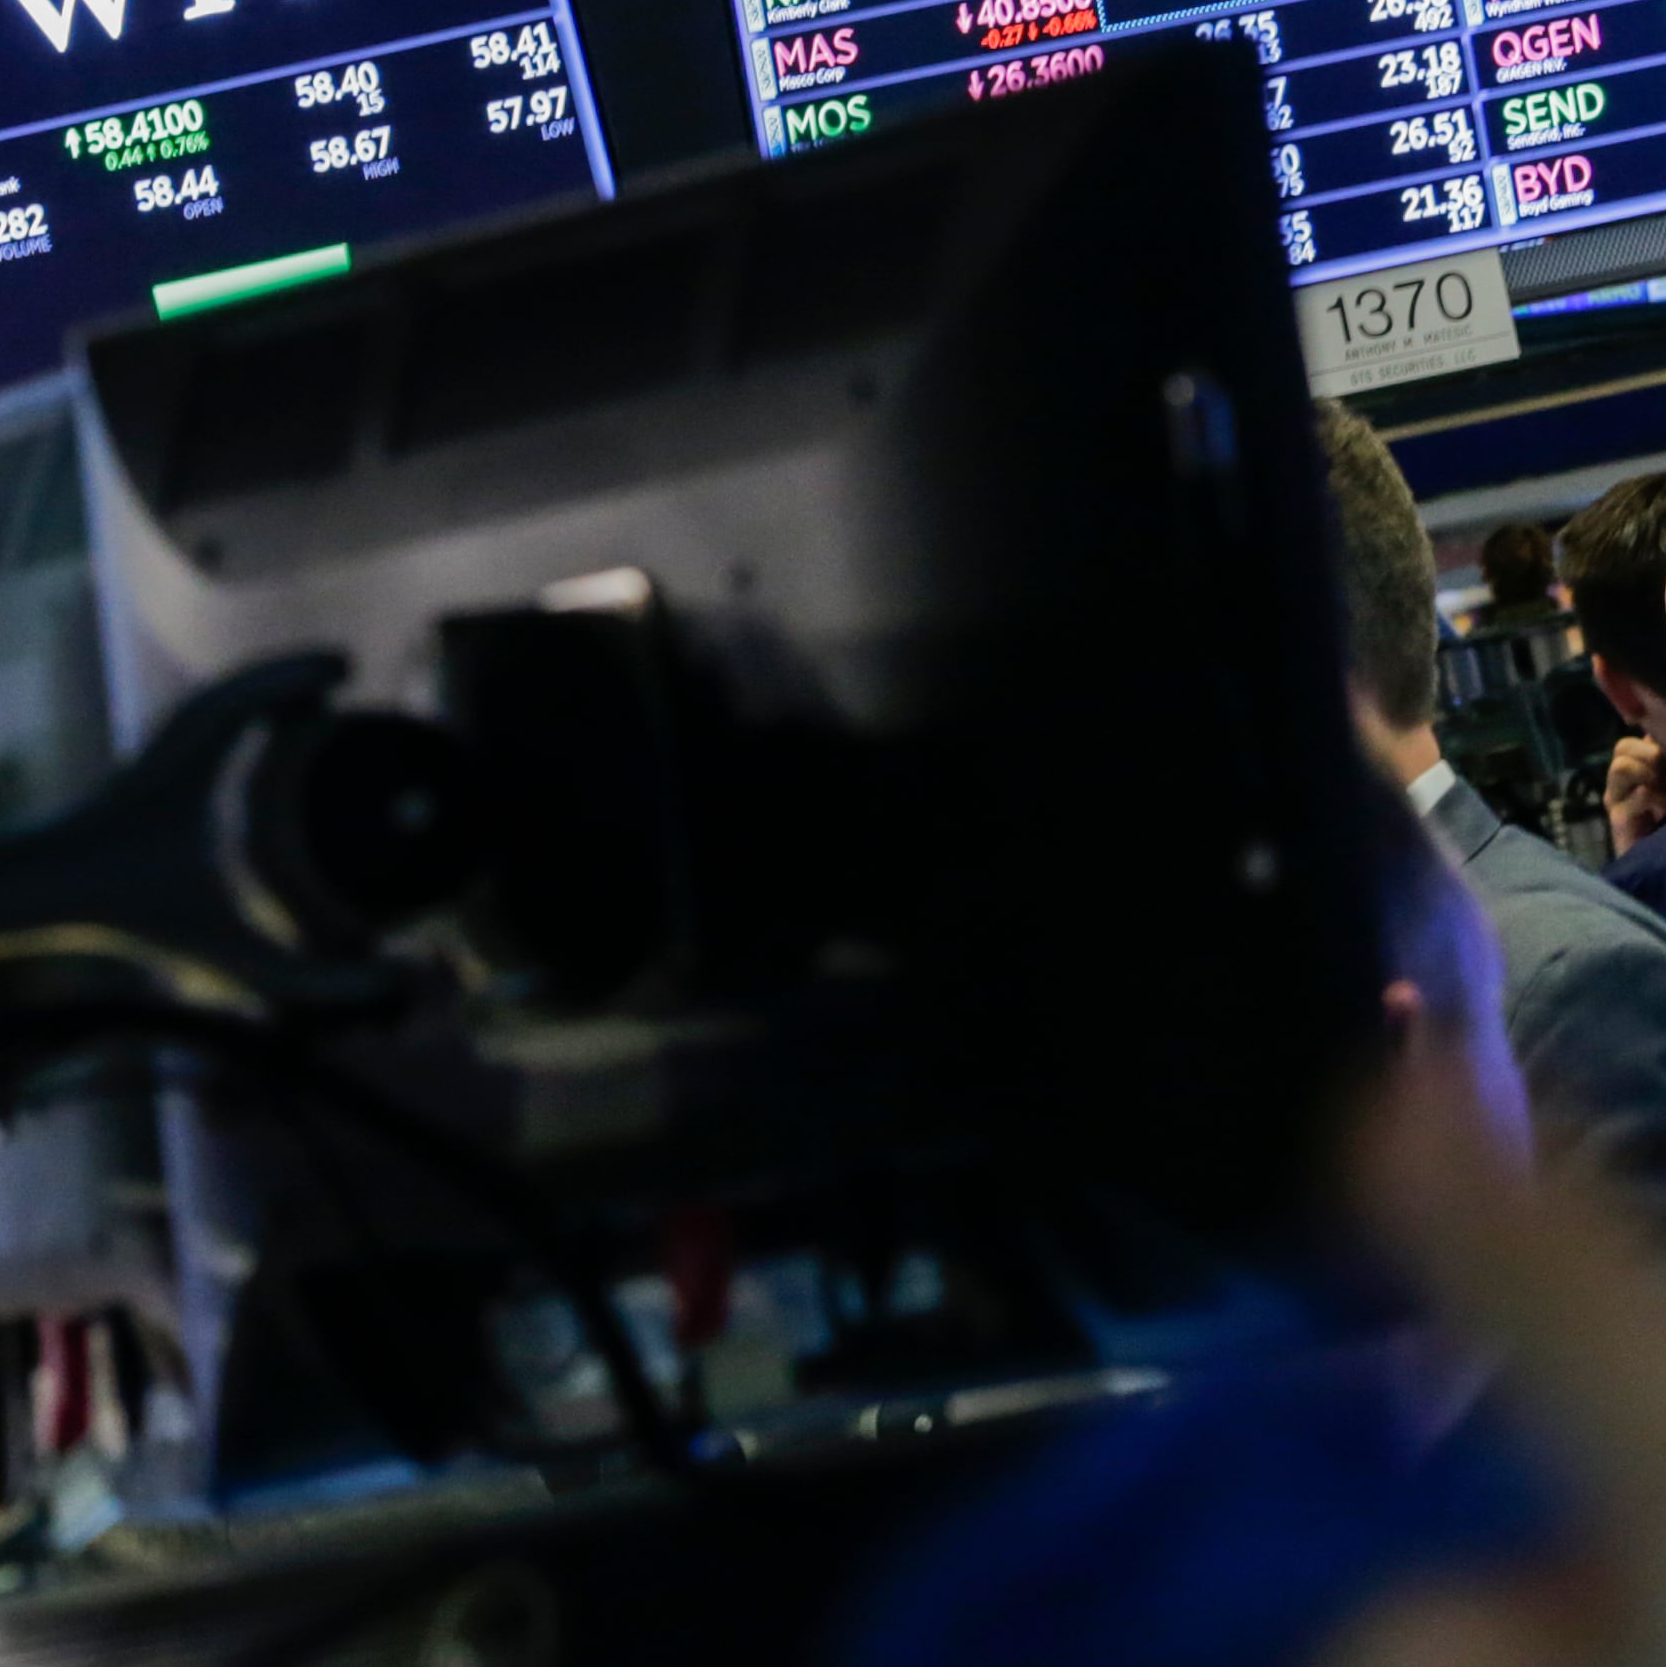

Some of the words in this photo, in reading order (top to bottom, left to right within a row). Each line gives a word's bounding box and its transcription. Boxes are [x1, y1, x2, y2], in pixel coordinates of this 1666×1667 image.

[470, 22, 557, 69] 58.41
[774, 28, 859, 76] MAS
[1492, 14, 1601, 68] QGEN
[295, 61, 379, 108] 58.40
[520, 51, 561, 80] 114
[1378, 42, 1462, 88] 23.18
[357, 89, 385, 117] 15
[486, 86, 567, 134] 57.97
[1503, 83, 1605, 135] SEND
[85, 99, 203, 155] 58.4100
[309, 125, 391, 173] 58.67
[541, 117, 575, 141] LOW
[1390, 109, 1473, 155] 26.51
[135, 165, 219, 213] 58.44
[363, 157, 400, 181] HIGH
[1513, 154, 1592, 203] BYD
[184, 197, 223, 221] OPEN
[1400, 175, 1484, 222] 21.36
[1448, 202, 1485, 234] 117
[1519, 195, 1548, 217] Boyd
[1549, 188, 1594, 213] Gaming
[1326, 272, 1473, 344] 1370
[1345, 341, 1396, 361] ANTHONY
[1379, 355, 1445, 377] SECURITIES
